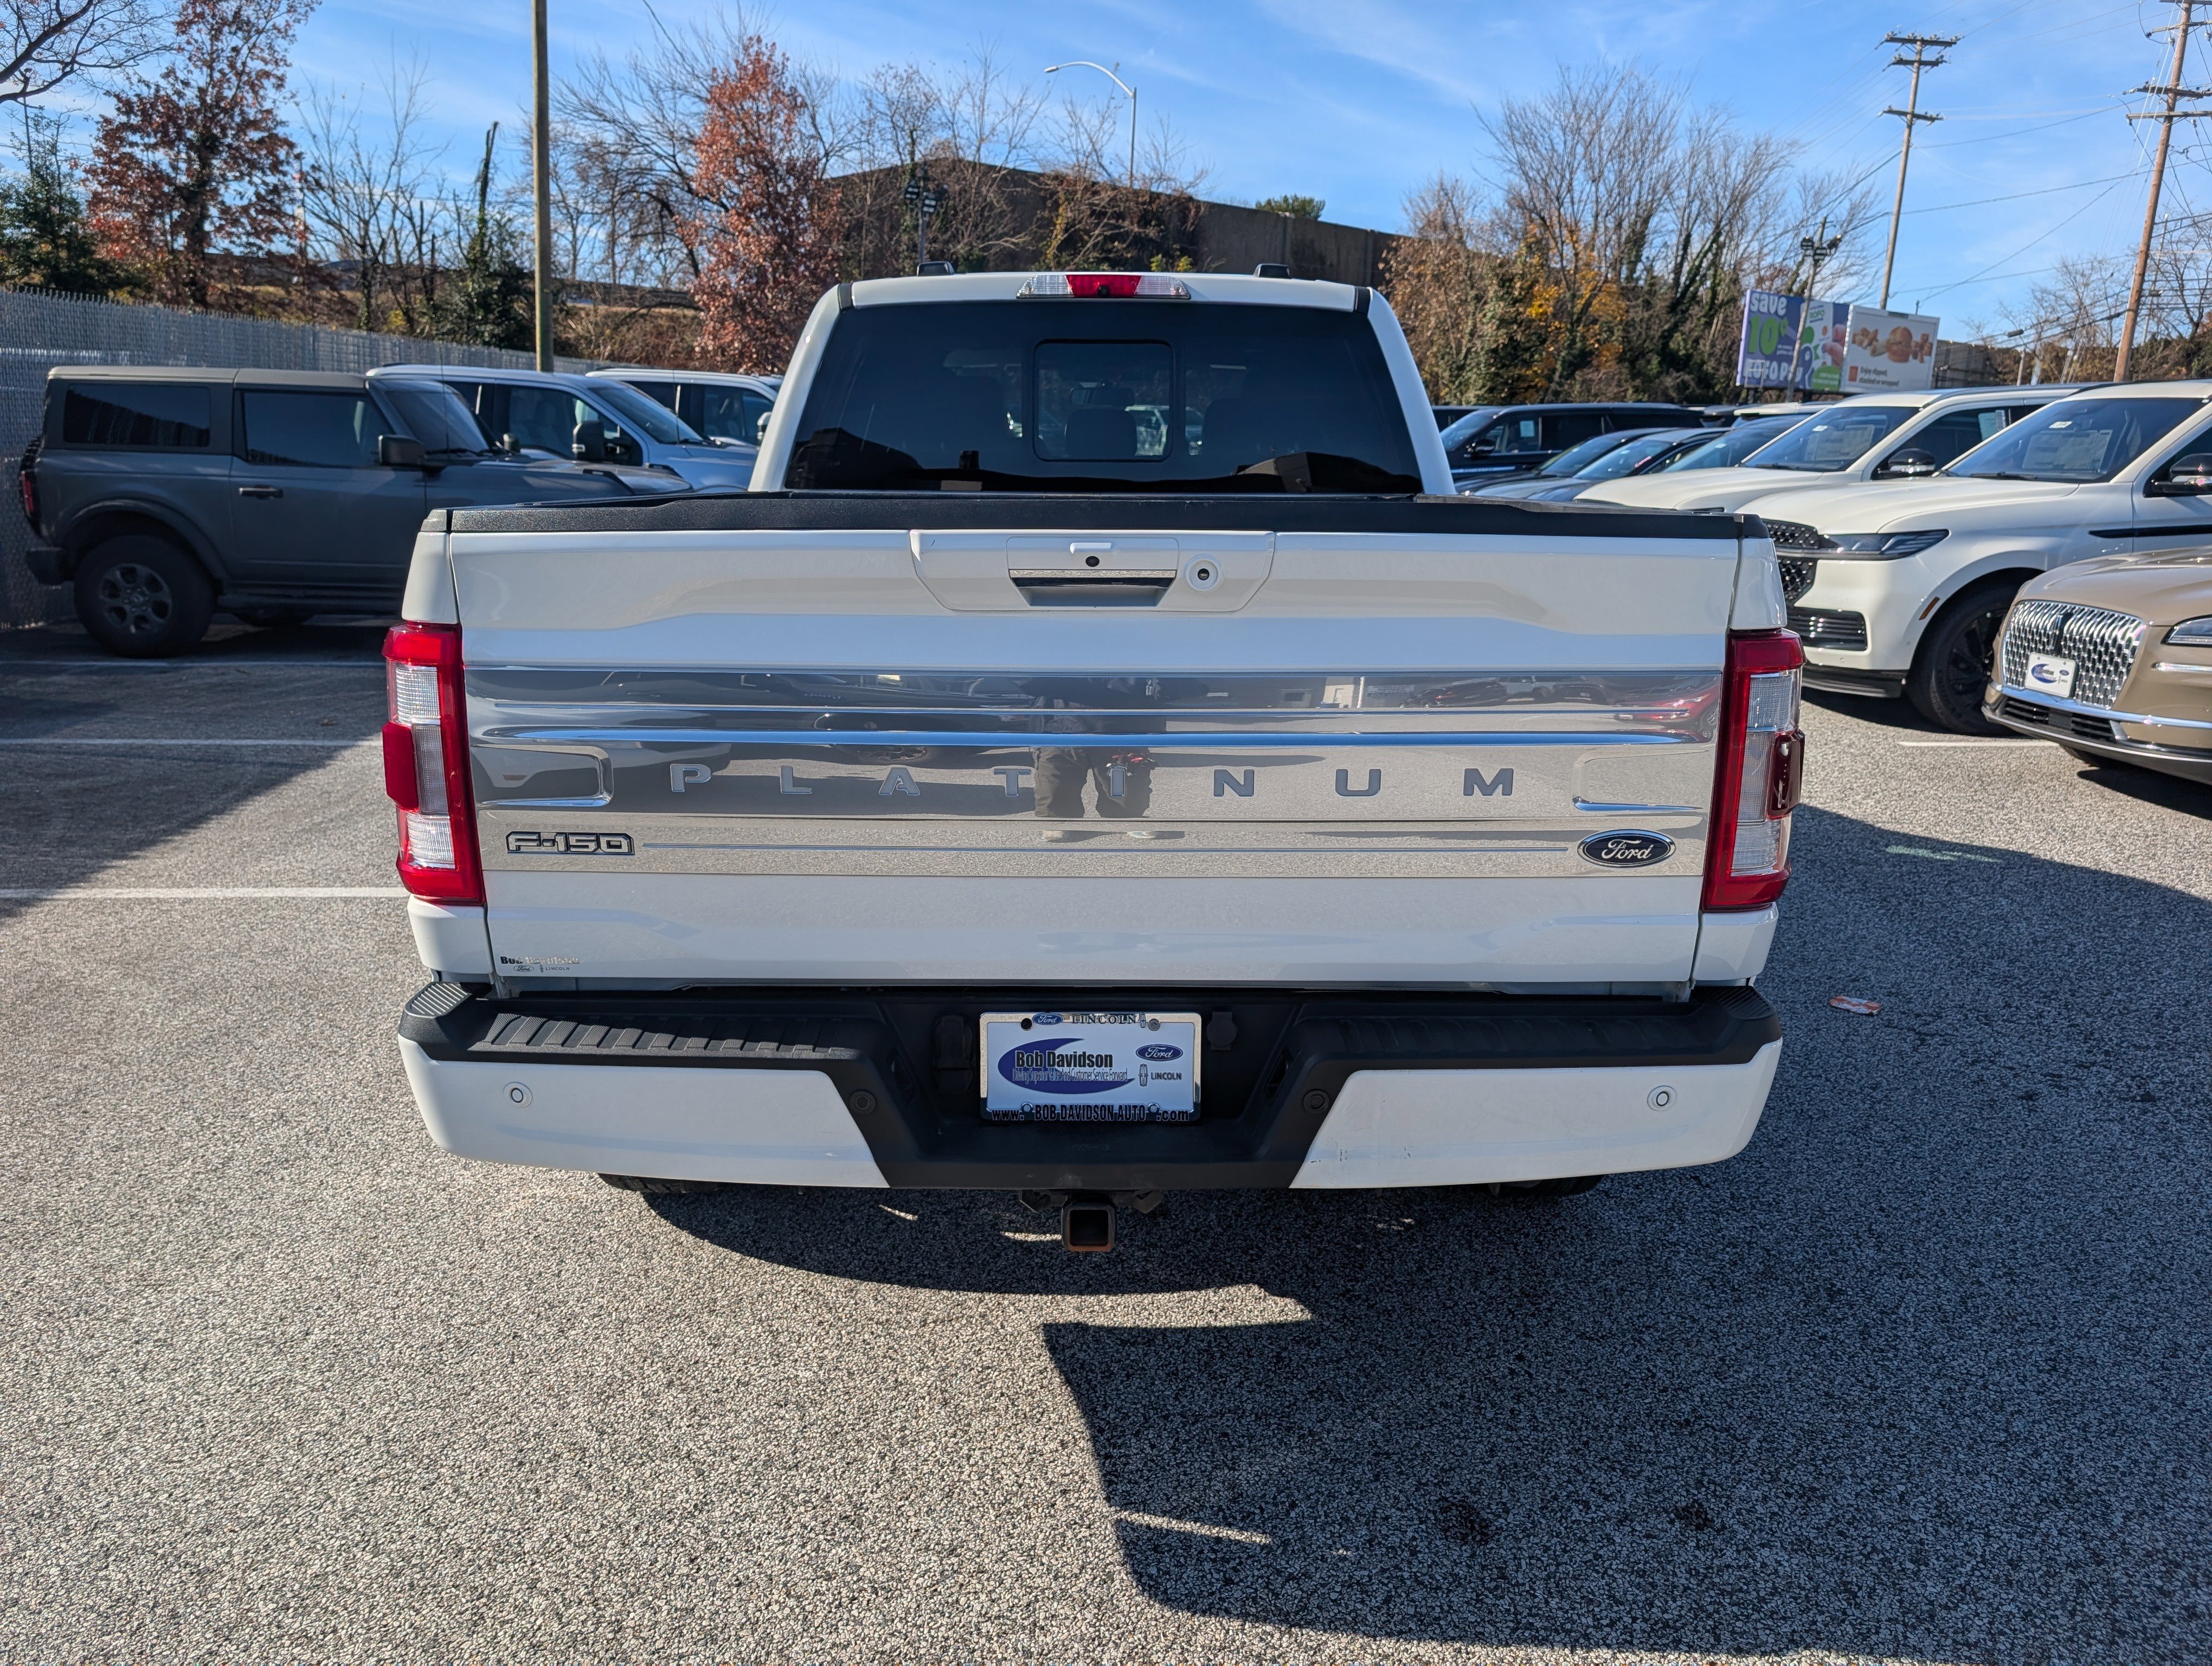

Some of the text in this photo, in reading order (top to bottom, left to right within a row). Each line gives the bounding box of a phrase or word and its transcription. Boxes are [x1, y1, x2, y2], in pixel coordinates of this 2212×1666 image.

[670, 762, 1514, 796] PLATINUM
[506, 831, 635, 855] F-150
[1071, 1014, 1137, 1024] LINCOLN
[1015, 1050, 1114, 1068] Bob Davidson
[1071, 1068, 1092, 1081] Customer
[1093, 1068, 1109, 1081] Service
[1109, 1068, 1128, 1081] Forward
[1150, 1072, 1182, 1080] LINCOLN
[992, 1104, 1189, 1122] www. BOB DAVIDSON AUTO .com
